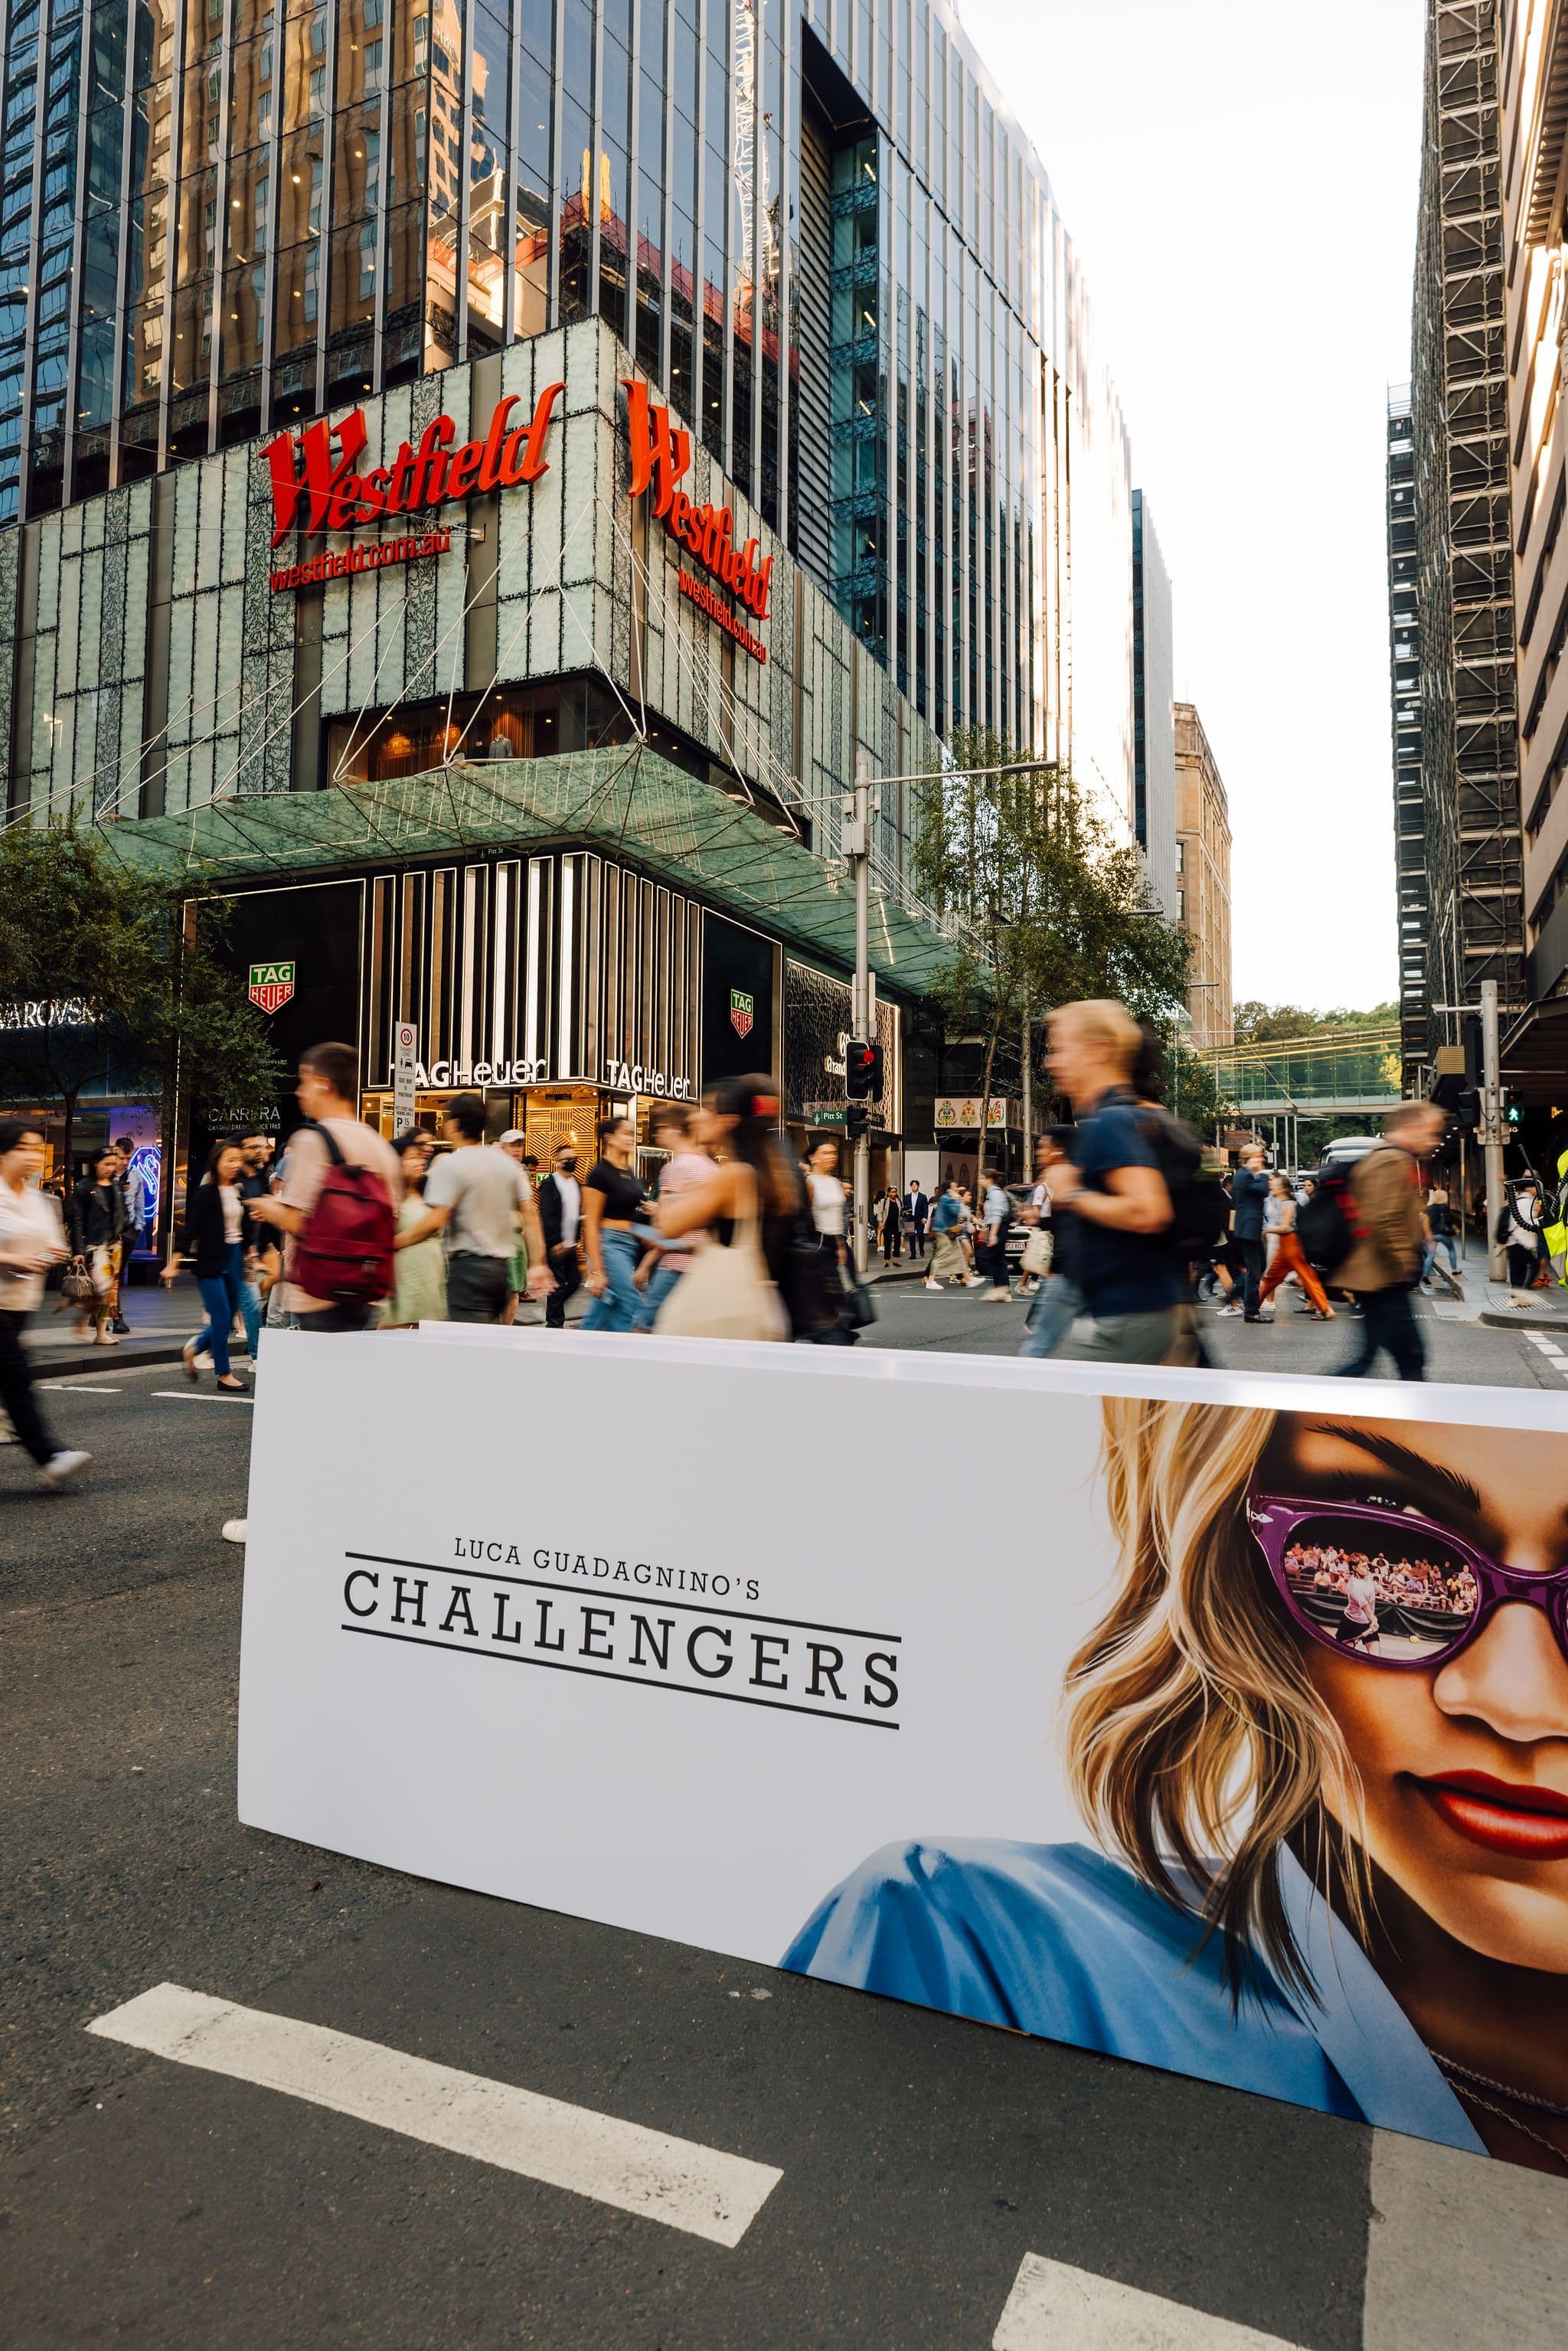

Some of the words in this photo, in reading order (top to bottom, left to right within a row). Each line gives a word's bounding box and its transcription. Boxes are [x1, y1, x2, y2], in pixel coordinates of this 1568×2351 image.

[259, 382, 567, 549] Westfield
[620, 379, 775, 621] Westfield
[270, 527, 451, 593] westfield.com.au
[679, 569, 766, 665] westfield.com.au
[251, 985, 292, 1011] HEUER
[253, 965, 291, 984] TAG
[732, 1011, 752, 1035] HEUER
[733, 993, 752, 1013] TAG
[390, 1058, 547, 1089] AGHeuer
[397, 1117, 403, 1128] P
[404, 1118, 410, 1127] 15
[454, 1537, 522, 1566] LUCA
[533, 1549, 760, 1602] GUADAGNINO'S
[343, 1569, 900, 1709] CHALLENGERS
